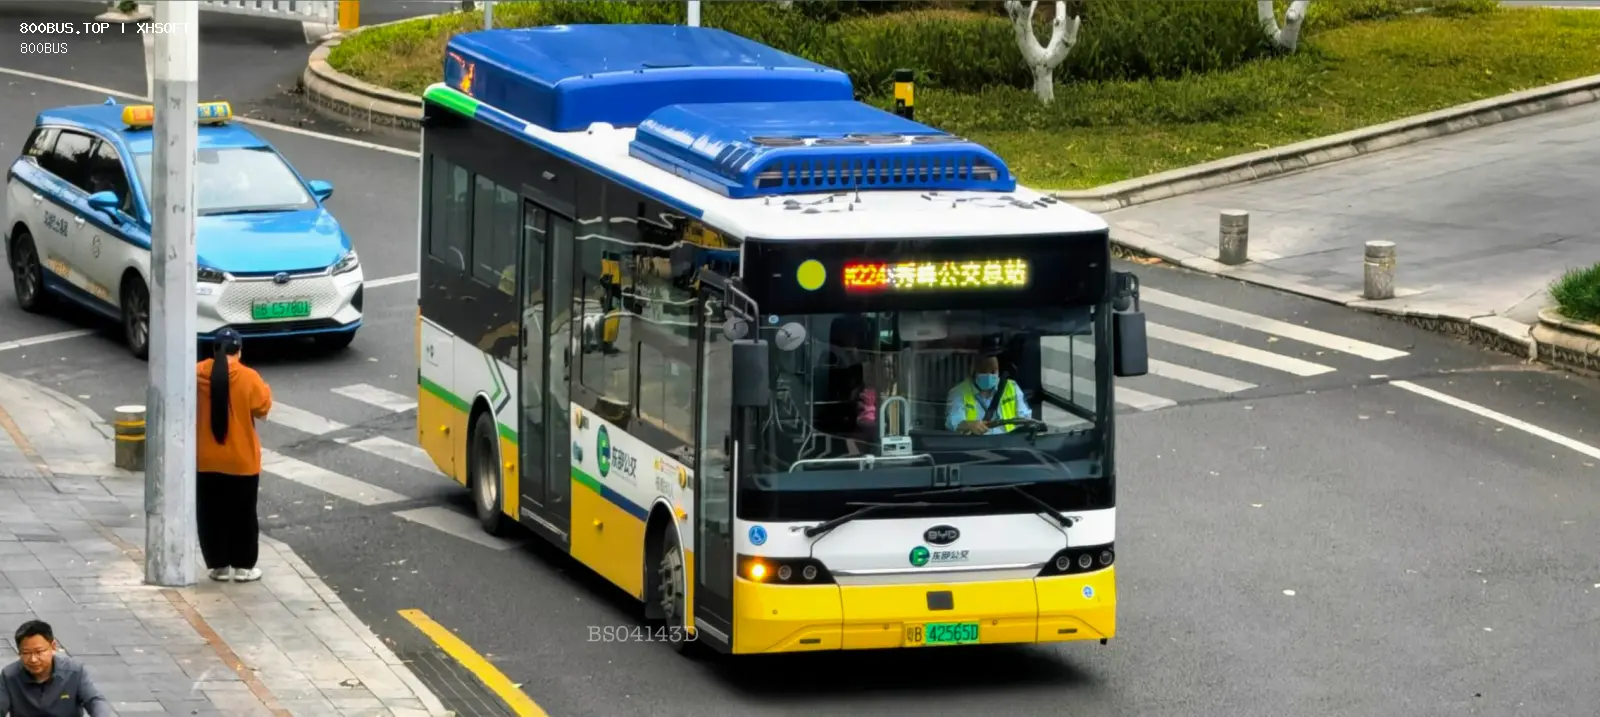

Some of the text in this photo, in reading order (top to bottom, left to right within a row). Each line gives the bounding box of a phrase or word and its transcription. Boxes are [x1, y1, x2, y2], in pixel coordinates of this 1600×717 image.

[611, 445, 638, 479] 东部公交
[928, 529, 958, 541] BYD
[931, 549, 970, 561] 东部公交
[928, 623, 979, 642] 42565D
